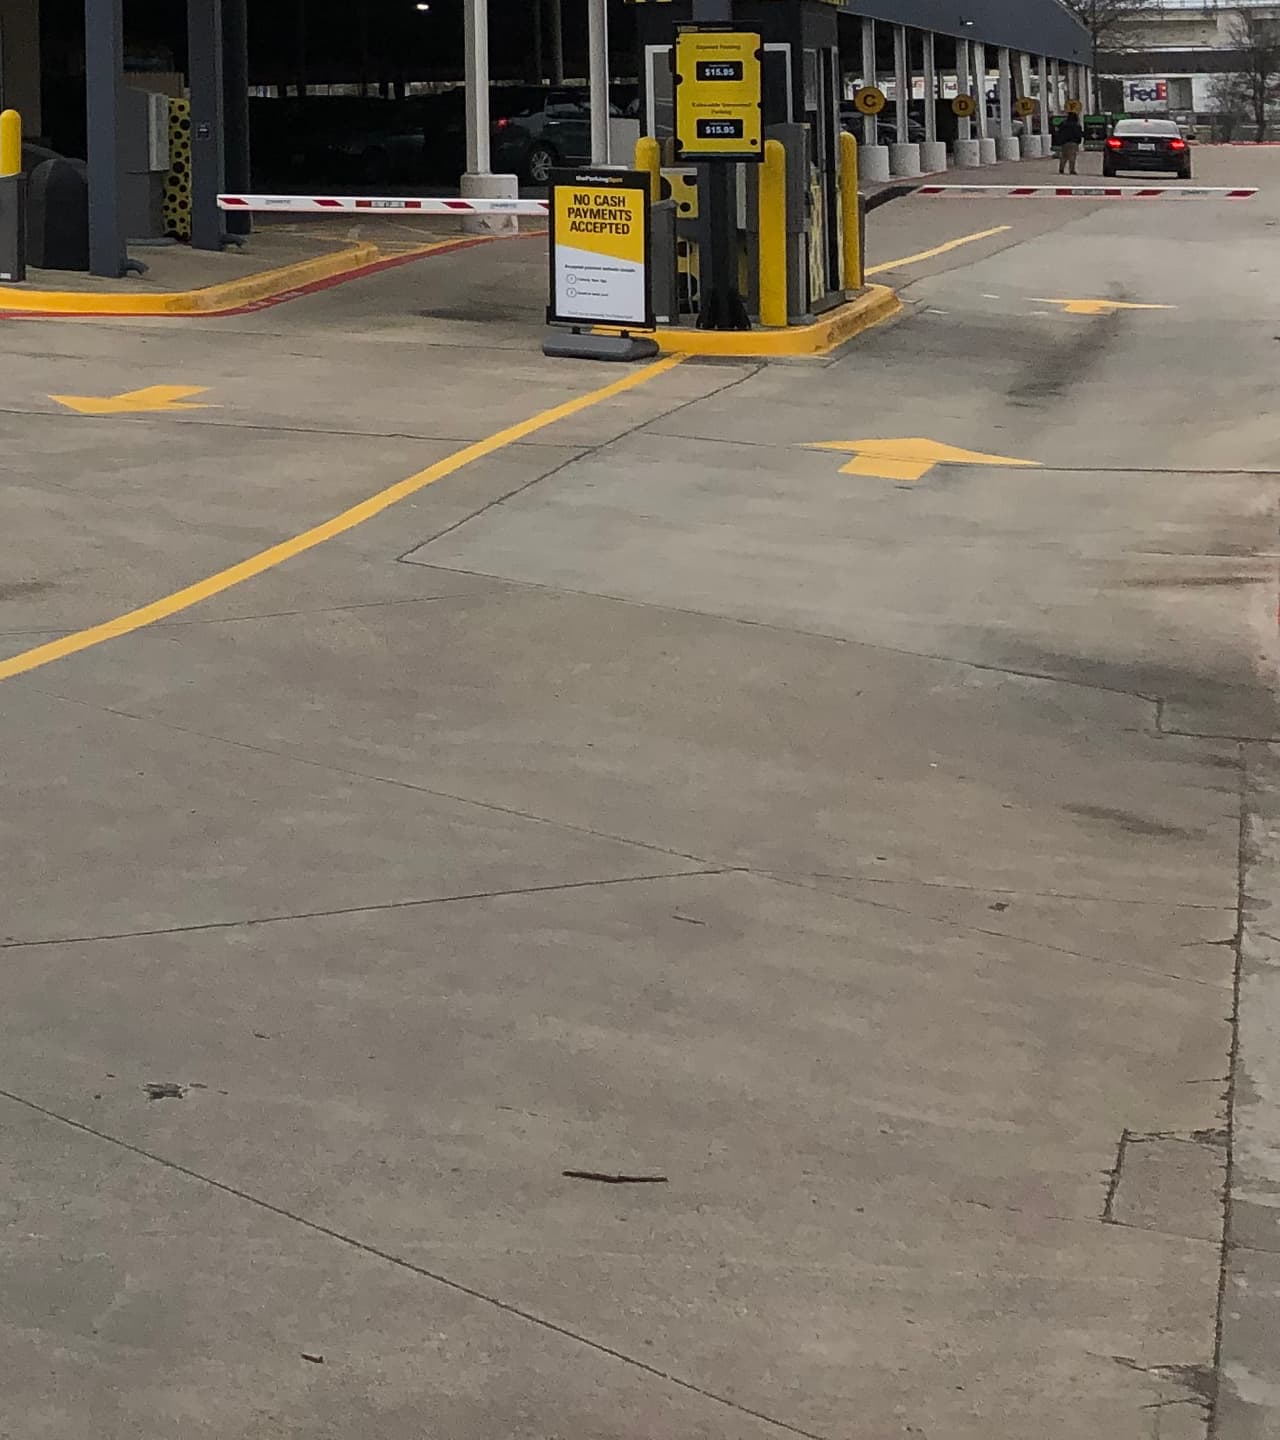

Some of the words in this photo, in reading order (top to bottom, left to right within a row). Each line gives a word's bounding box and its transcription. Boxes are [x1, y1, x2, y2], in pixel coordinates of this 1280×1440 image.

[863, 94, 876, 108] C
[573, 193, 590, 206] NO
[593, 194, 626, 208] CASH
[567, 207, 632, 222] PAYMENTS
[569, 221, 630, 235] ACCEPTED
